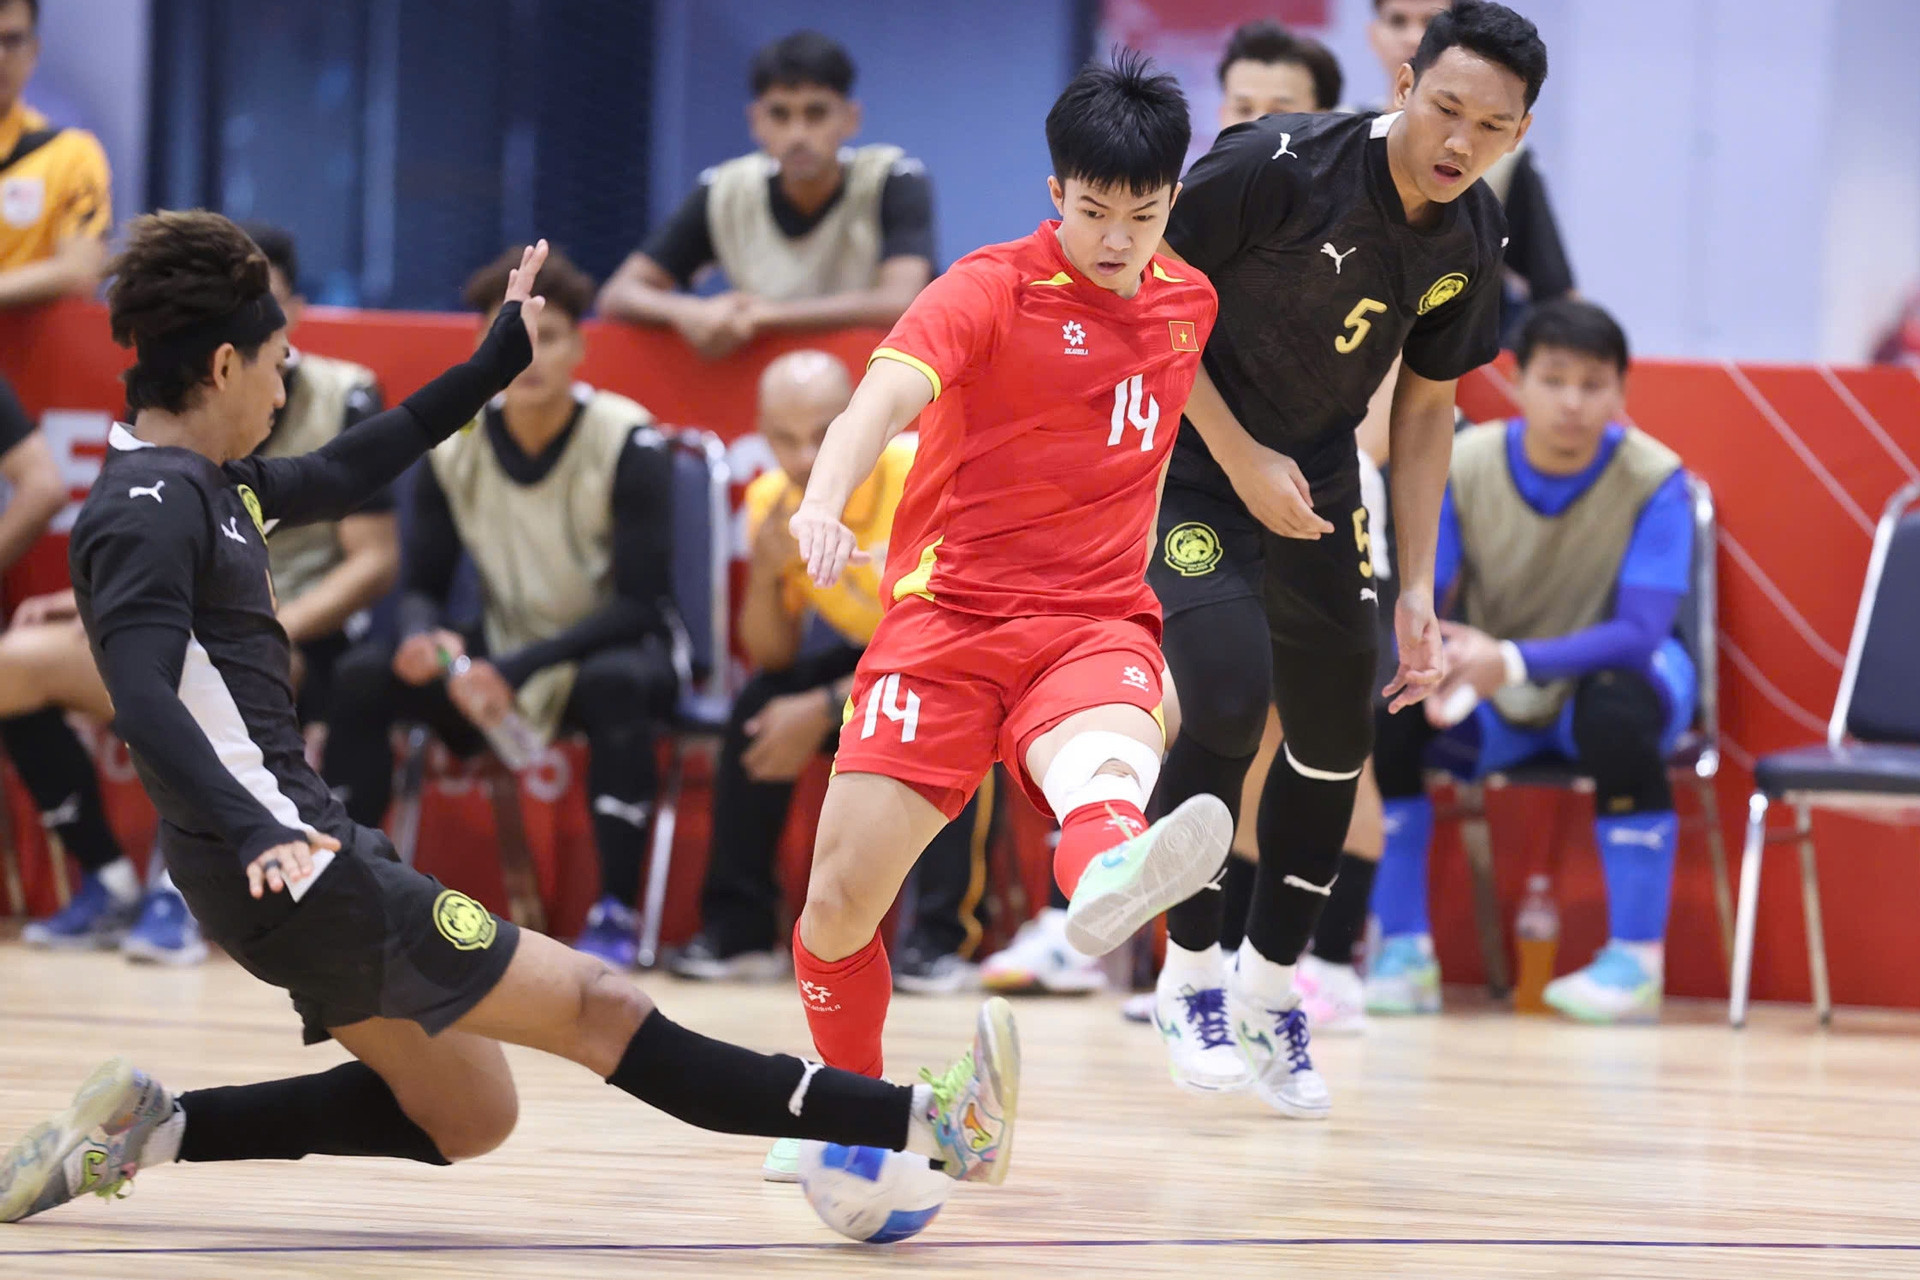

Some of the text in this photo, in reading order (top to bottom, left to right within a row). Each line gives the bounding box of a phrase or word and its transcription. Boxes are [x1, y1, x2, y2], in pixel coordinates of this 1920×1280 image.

[1334, 297, 1388, 354] 5
[1107, 373, 1160, 452] 14
[1351, 506, 1374, 578] 5
[860, 672, 922, 744] 14
